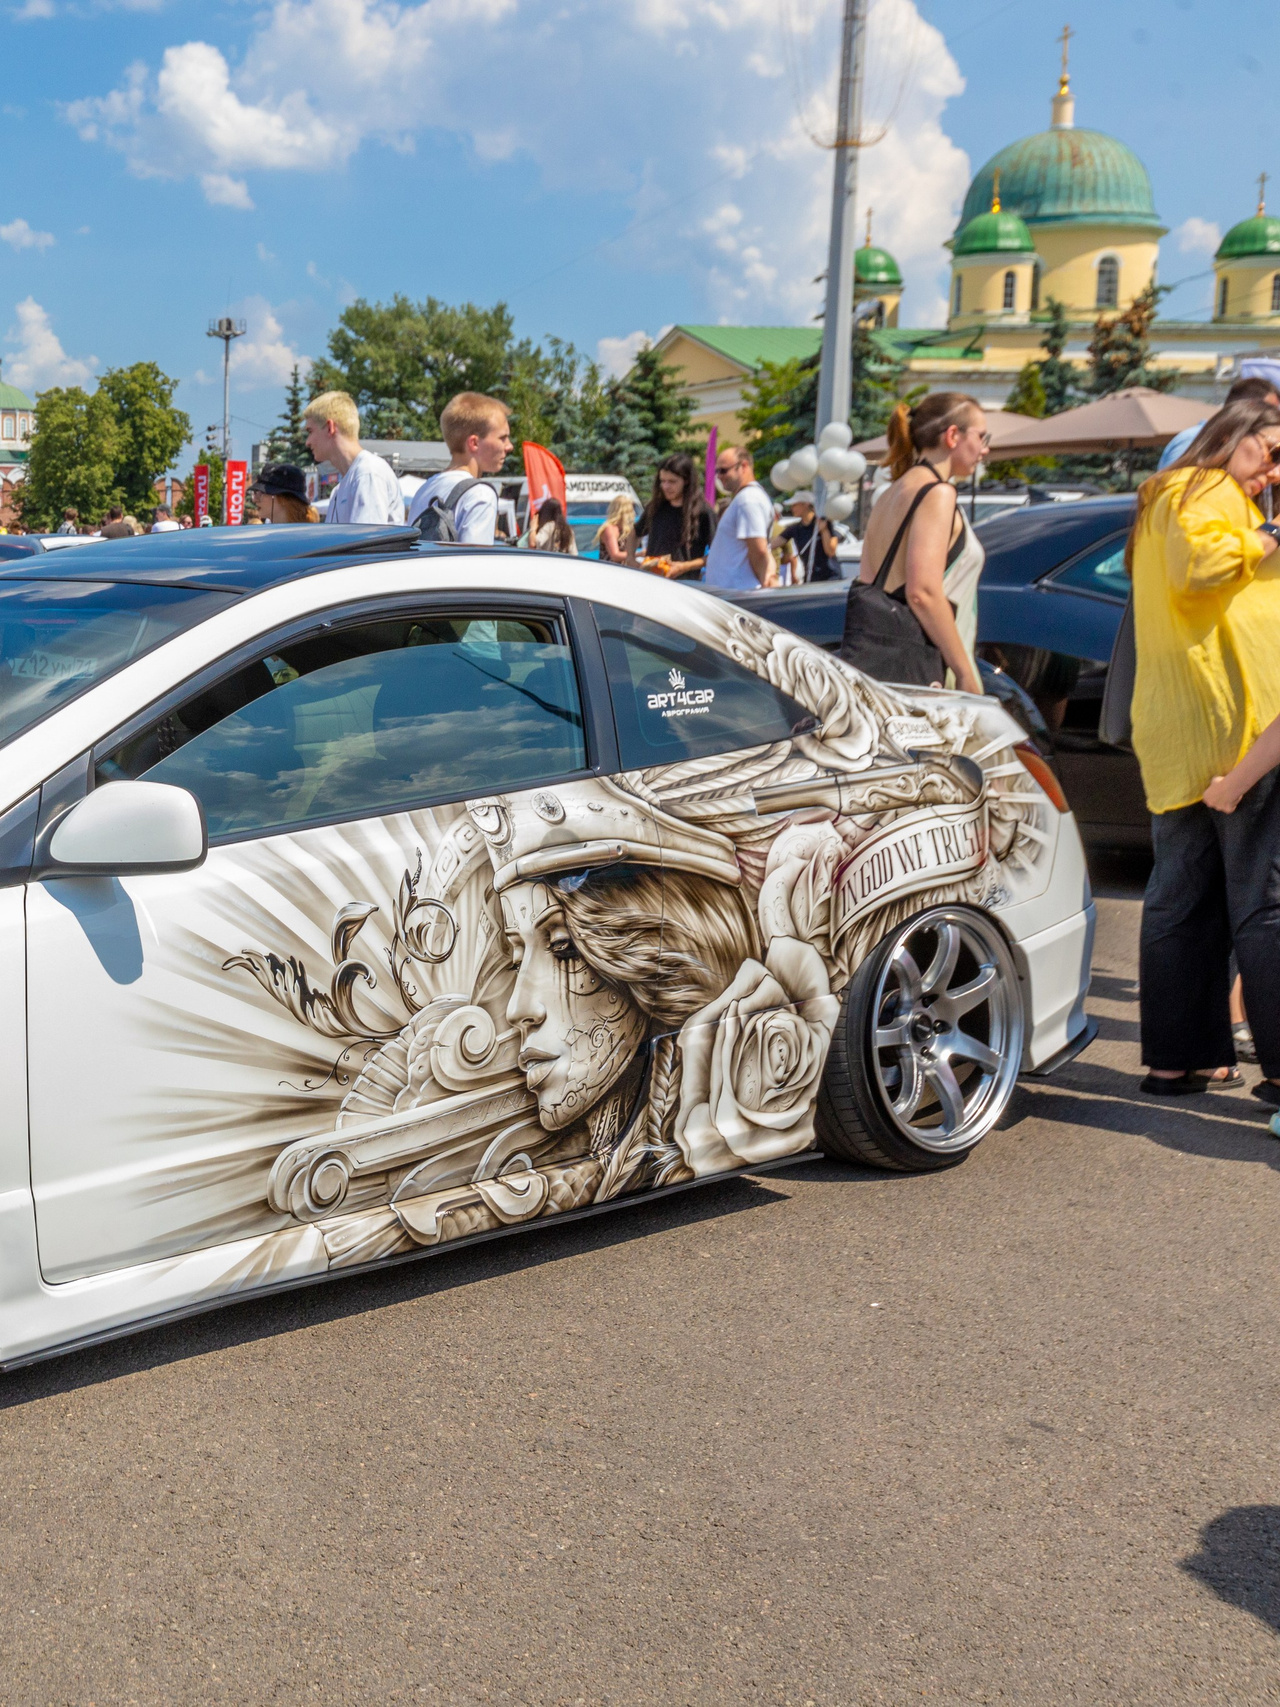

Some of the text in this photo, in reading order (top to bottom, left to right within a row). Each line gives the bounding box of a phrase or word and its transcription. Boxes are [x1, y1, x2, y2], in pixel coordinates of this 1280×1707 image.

[198, 475, 207, 516] to.ru
[230, 471, 243, 525] uto.ru
[841, 817, 984, 918] IN GOD WE TRUST
